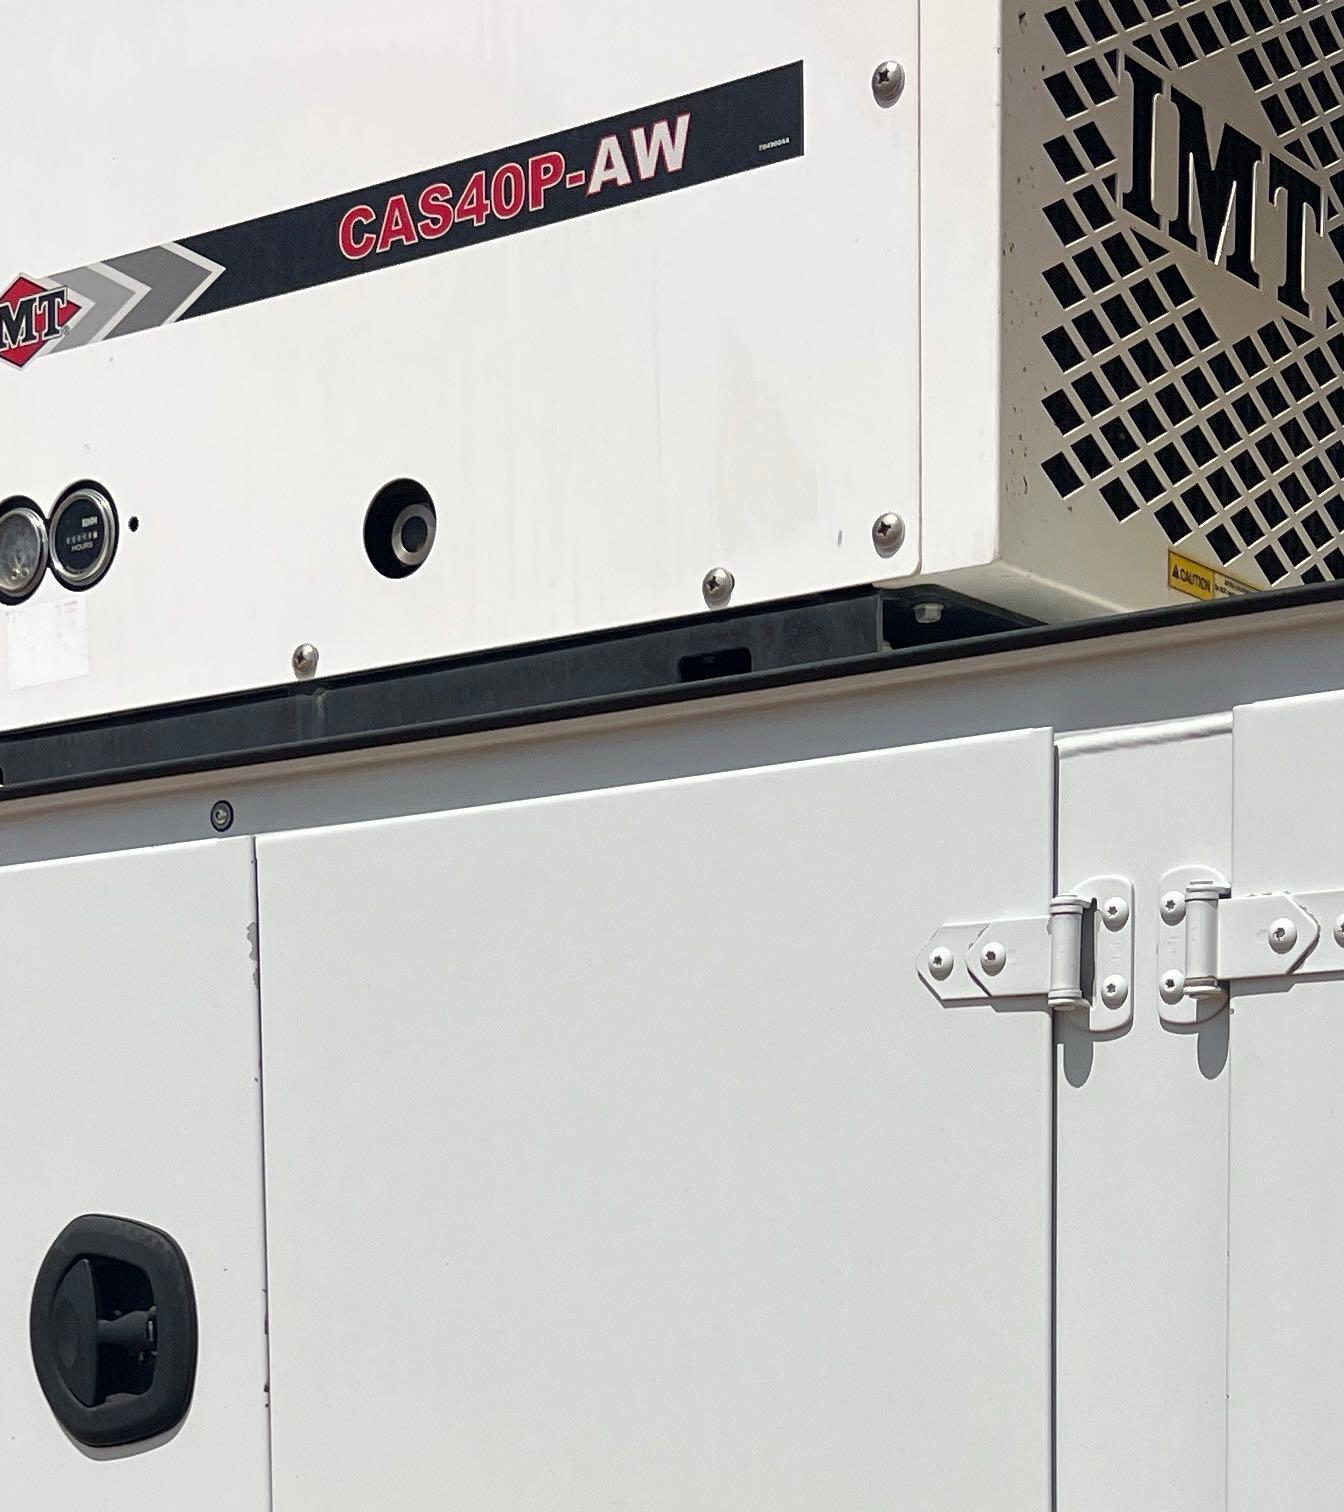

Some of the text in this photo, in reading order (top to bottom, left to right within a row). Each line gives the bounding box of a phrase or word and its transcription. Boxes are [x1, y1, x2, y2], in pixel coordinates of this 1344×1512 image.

[338, 111, 692, 260] CAS40P-AW
[1122, 52, 1322, 321] IMT
[1179, 568, 1211, 593] CAUTION
